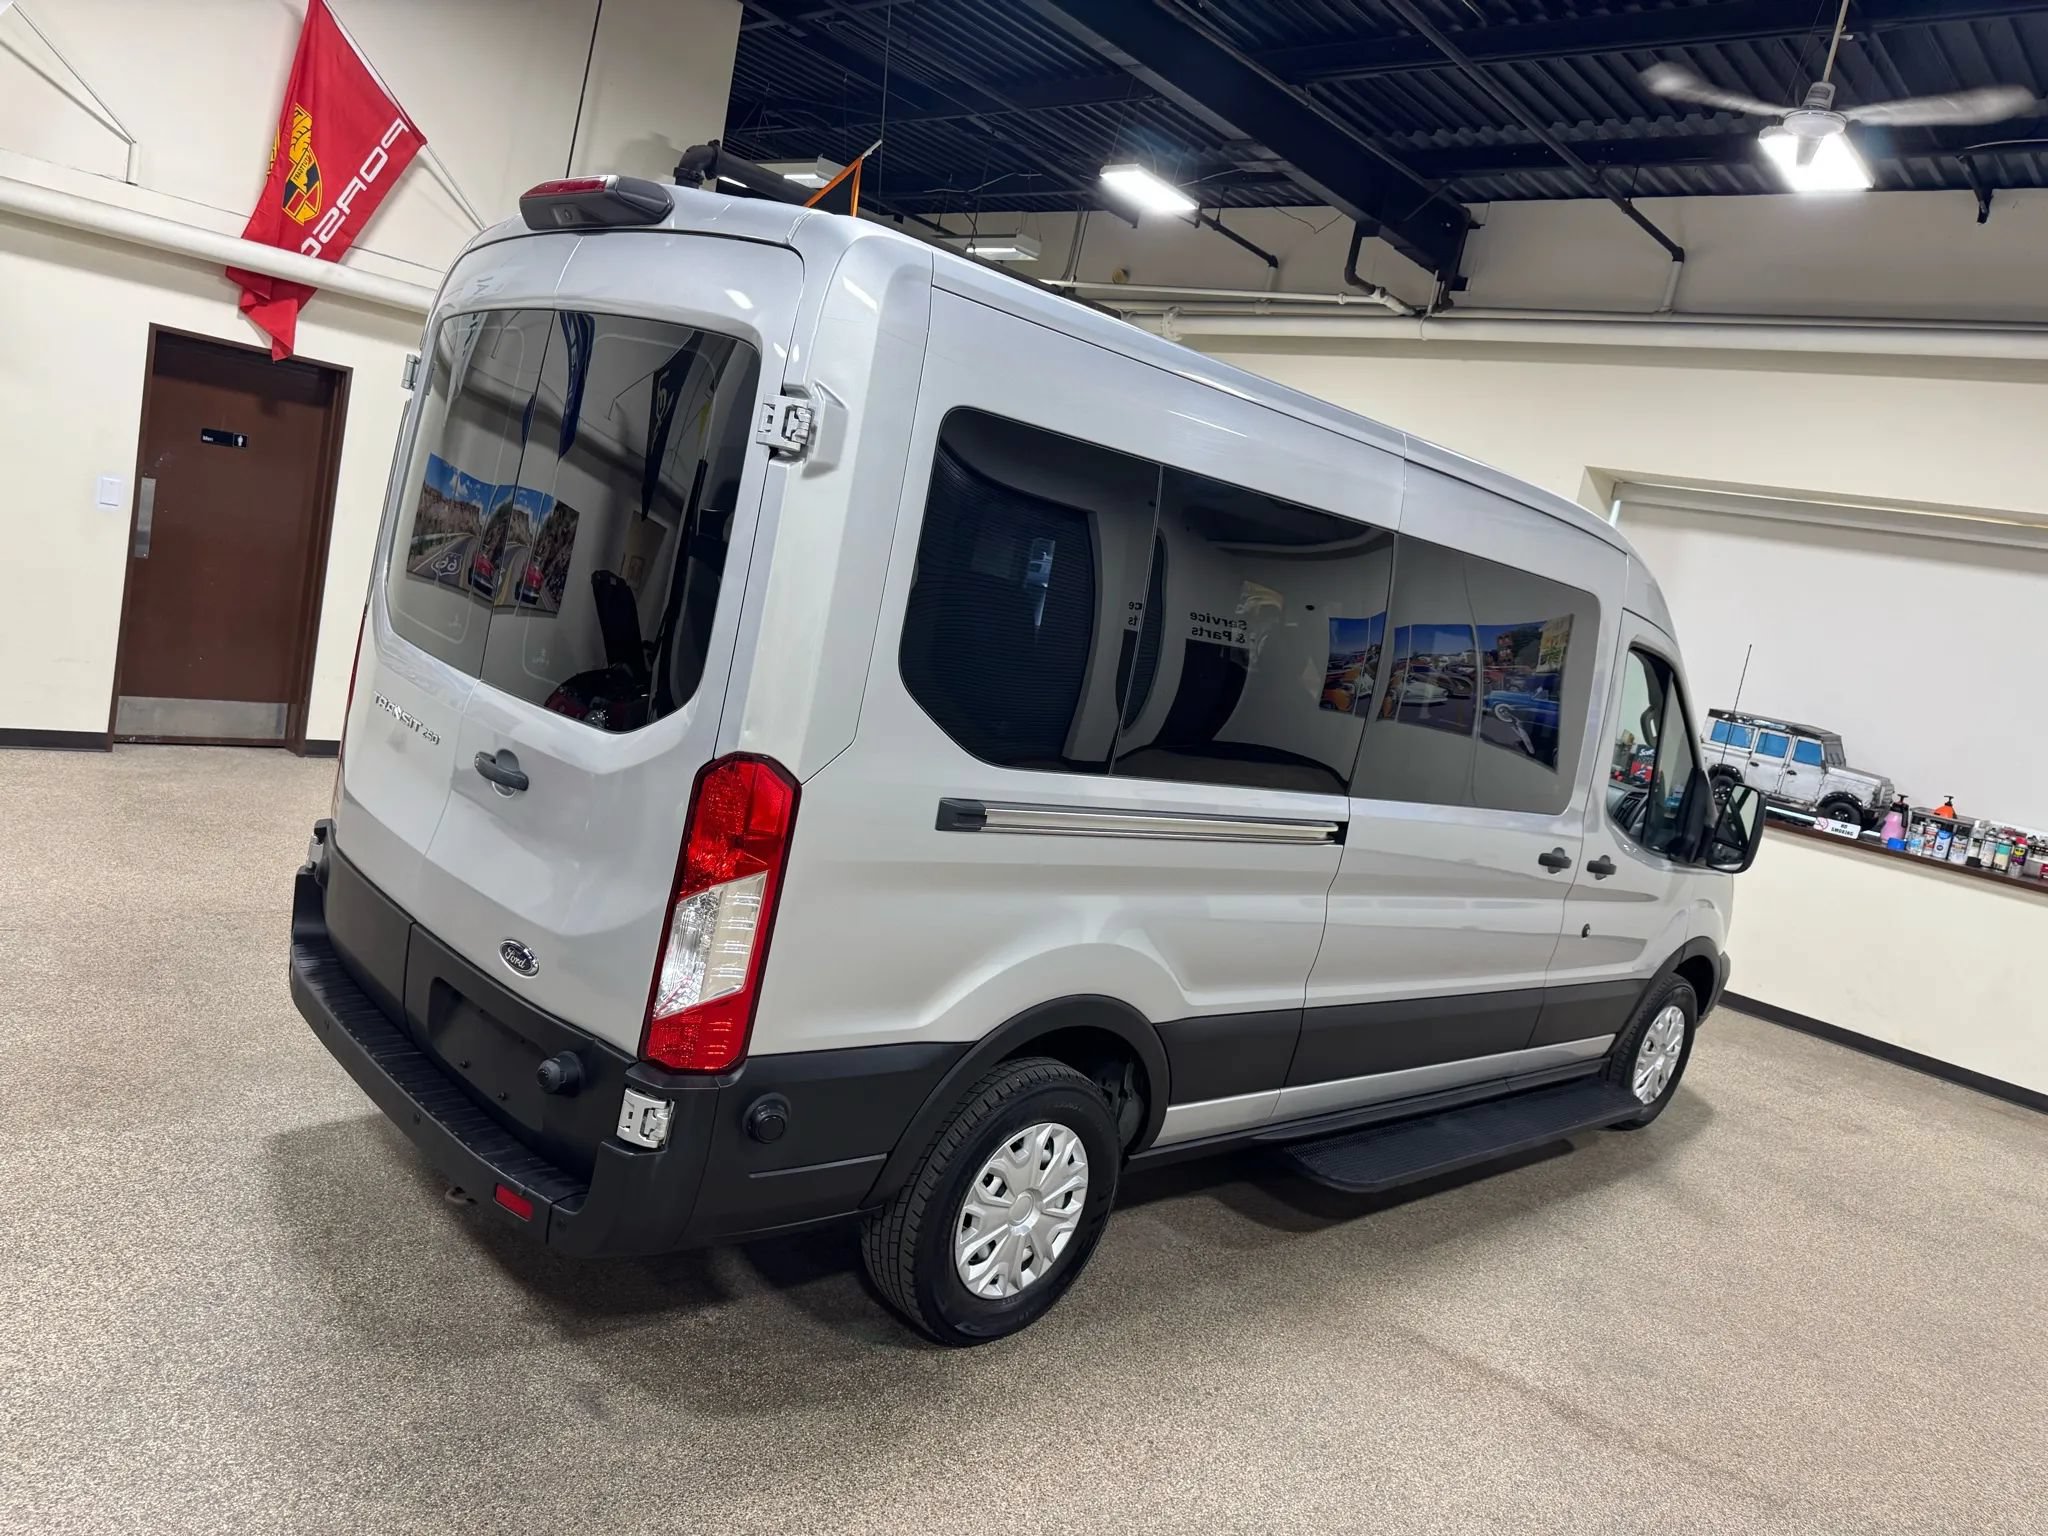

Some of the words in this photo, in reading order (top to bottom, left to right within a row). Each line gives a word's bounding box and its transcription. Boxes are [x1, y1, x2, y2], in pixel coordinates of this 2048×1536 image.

[374, 690, 424, 732] TRANSIT
[422, 727, 441, 745] 250
[505, 946, 526, 968] Ford
